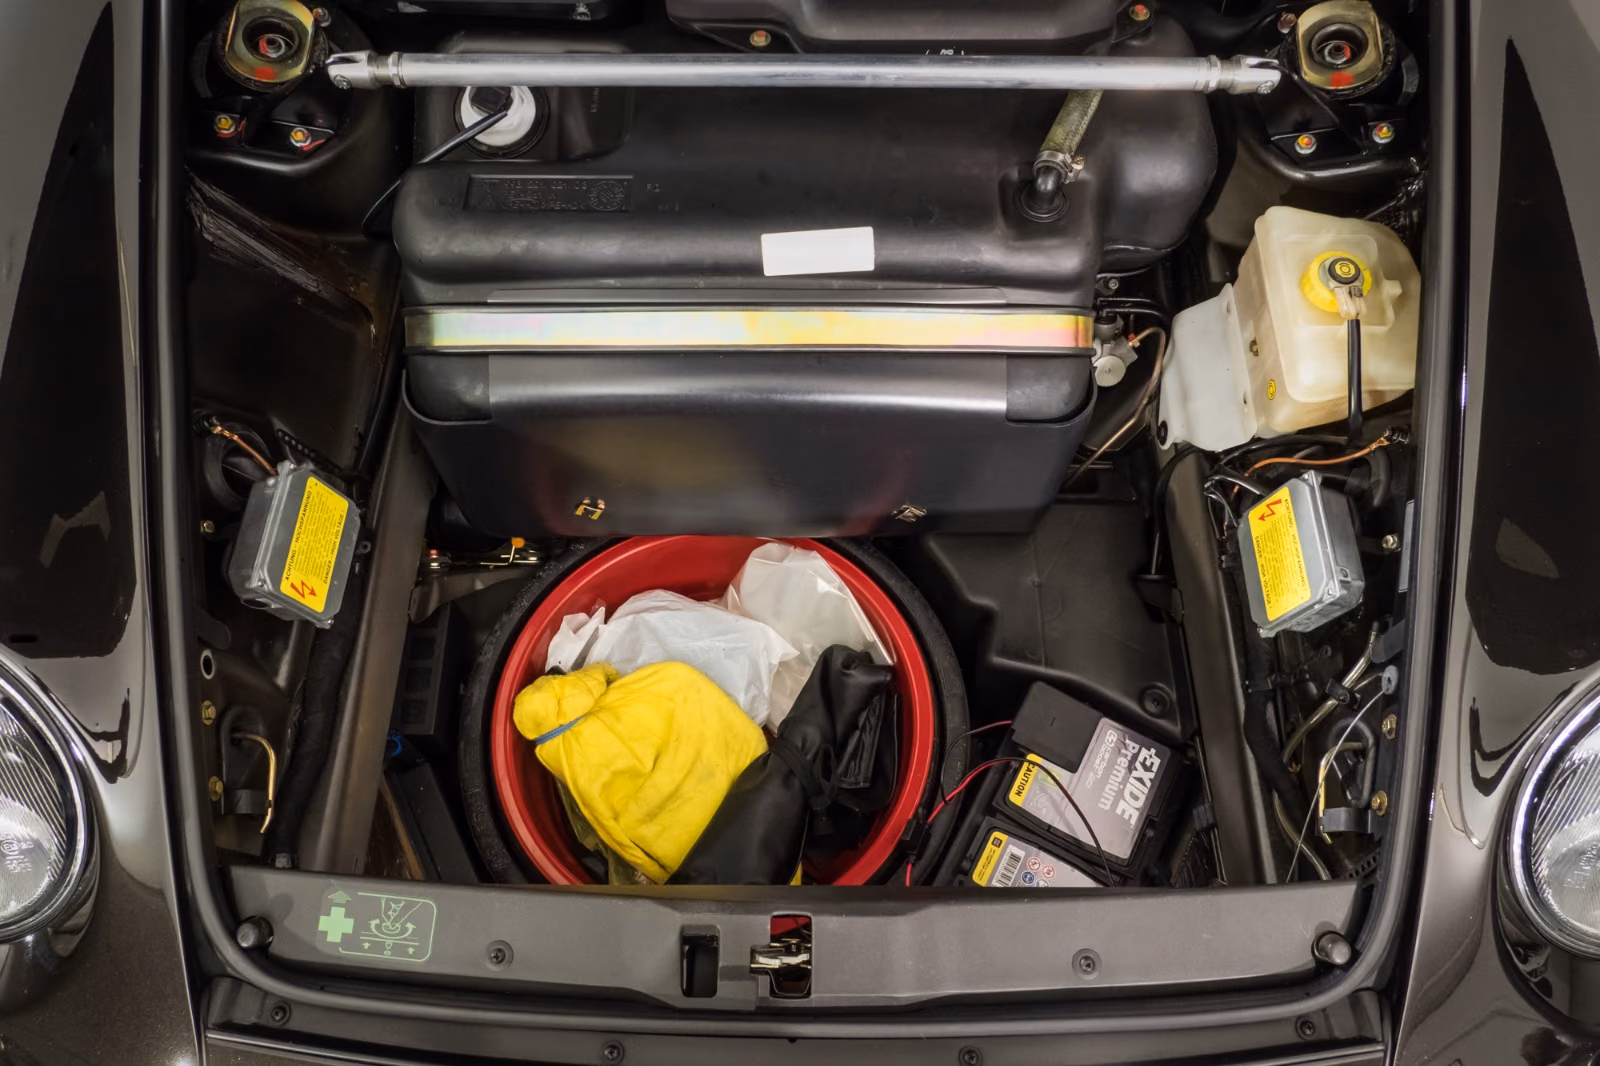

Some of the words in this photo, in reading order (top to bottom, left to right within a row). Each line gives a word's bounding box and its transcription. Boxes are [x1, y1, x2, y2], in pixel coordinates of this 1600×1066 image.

[285, 549, 296, 581] ACHTUNG
[295, 490, 312, 543] HOCHSPANNUNG
[323, 559, 332, 584] DANGER
[334, 514, 344, 539] VOLTAGE
[1014, 761, 1035, 797] CAUTION
[1098, 739, 1139, 811] Premium
[1115, 748, 1161, 826] EXIDE
